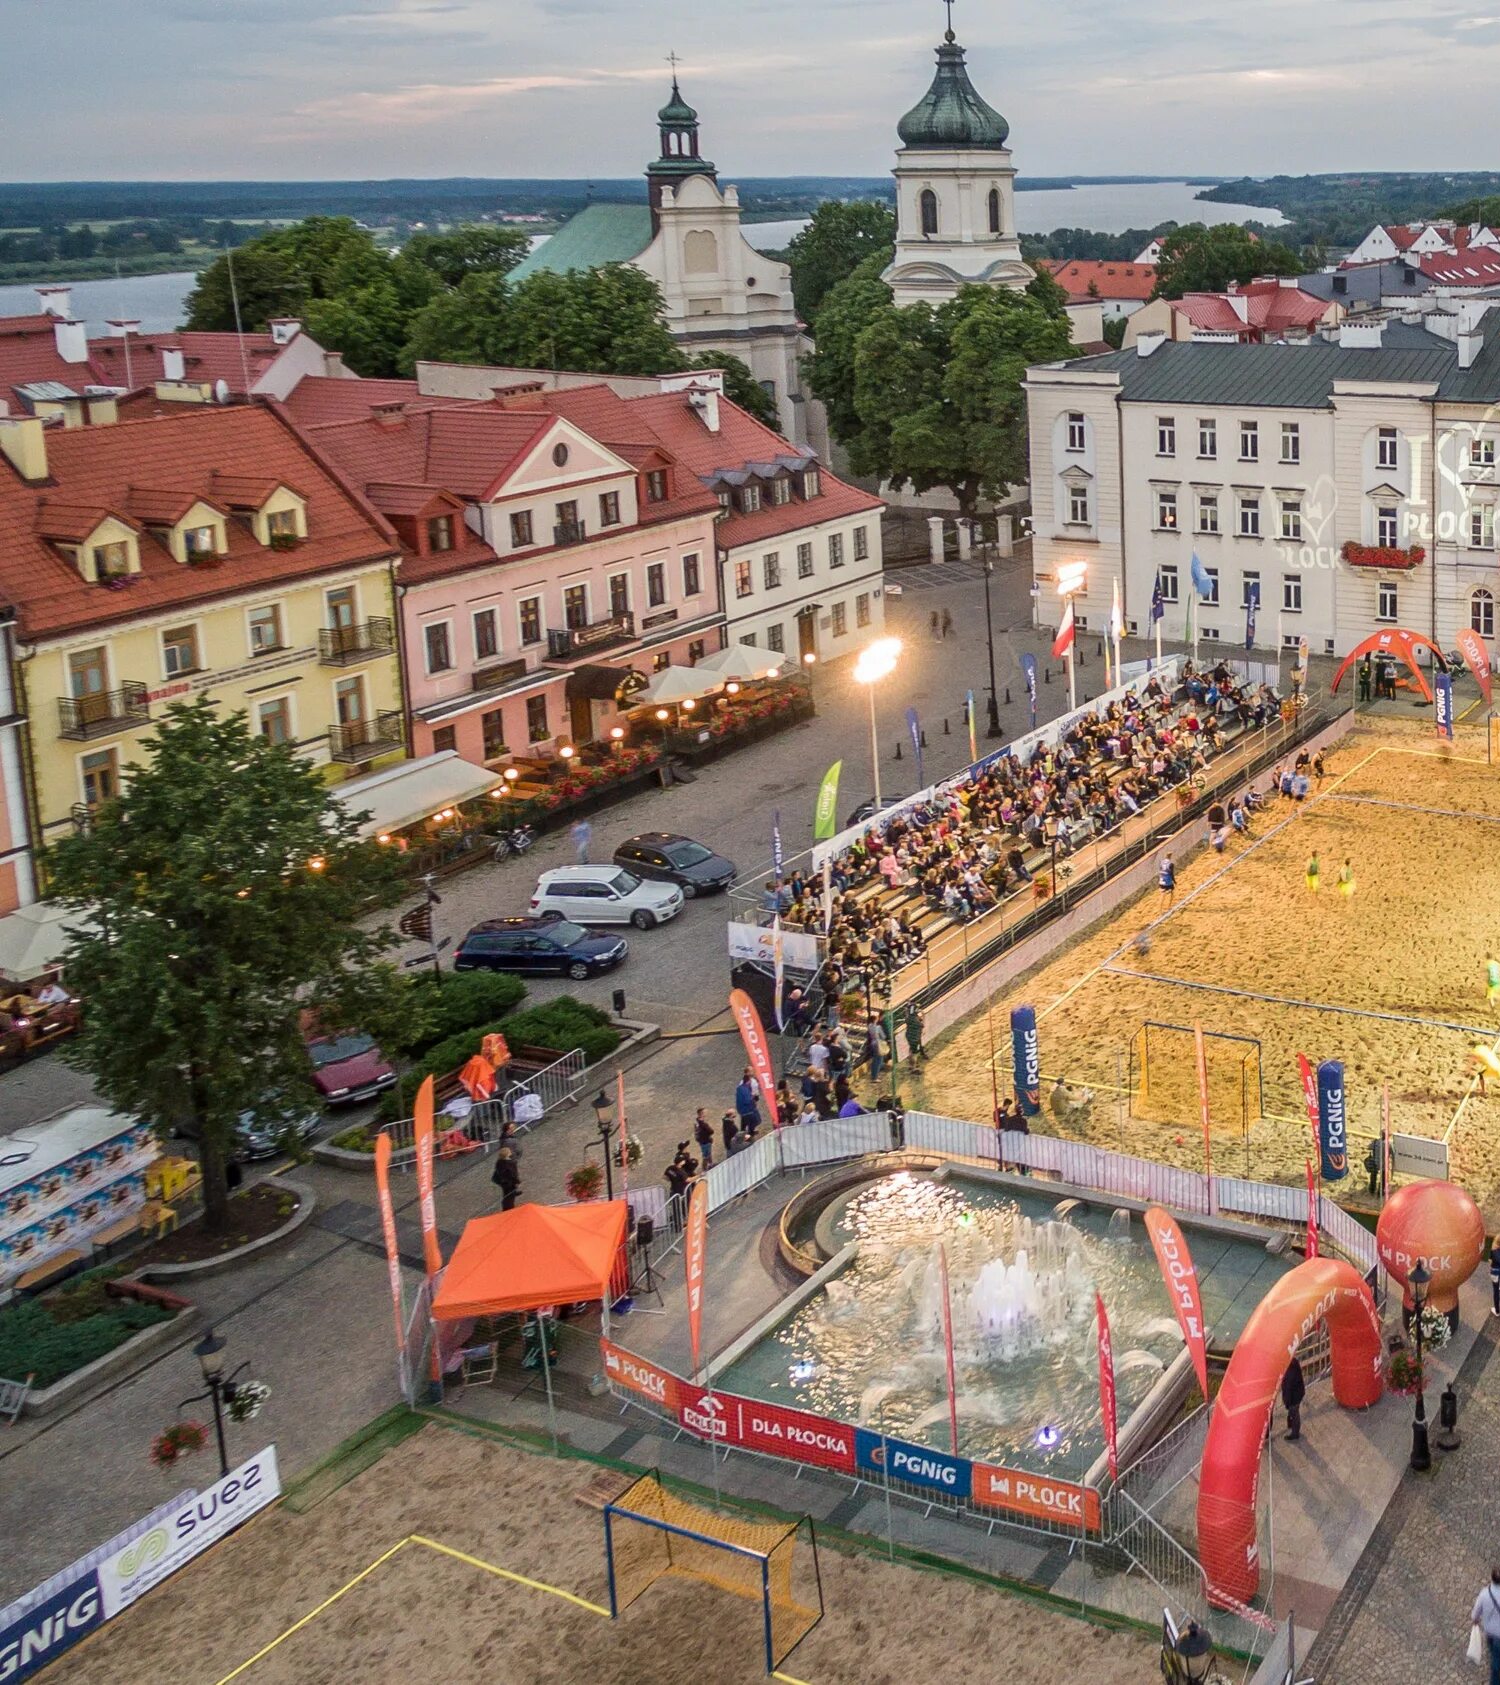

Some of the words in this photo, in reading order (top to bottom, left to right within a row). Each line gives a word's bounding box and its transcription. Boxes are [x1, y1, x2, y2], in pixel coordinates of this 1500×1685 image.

[1436, 688, 1446, 724] PGNiG
[1024, 1029, 1040, 1085] PGNiG
[1327, 1088, 1344, 1148] PGNiG
[623, 1360, 666, 1396] PŁOCK
[752, 1418, 783, 1438] DLA
[787, 1426, 848, 1455] PŁOCKA
[893, 1451, 957, 1485] PGNiG
[176, 1463, 262, 1540] suez
[1016, 1481, 1082, 1512] PŁOCK
